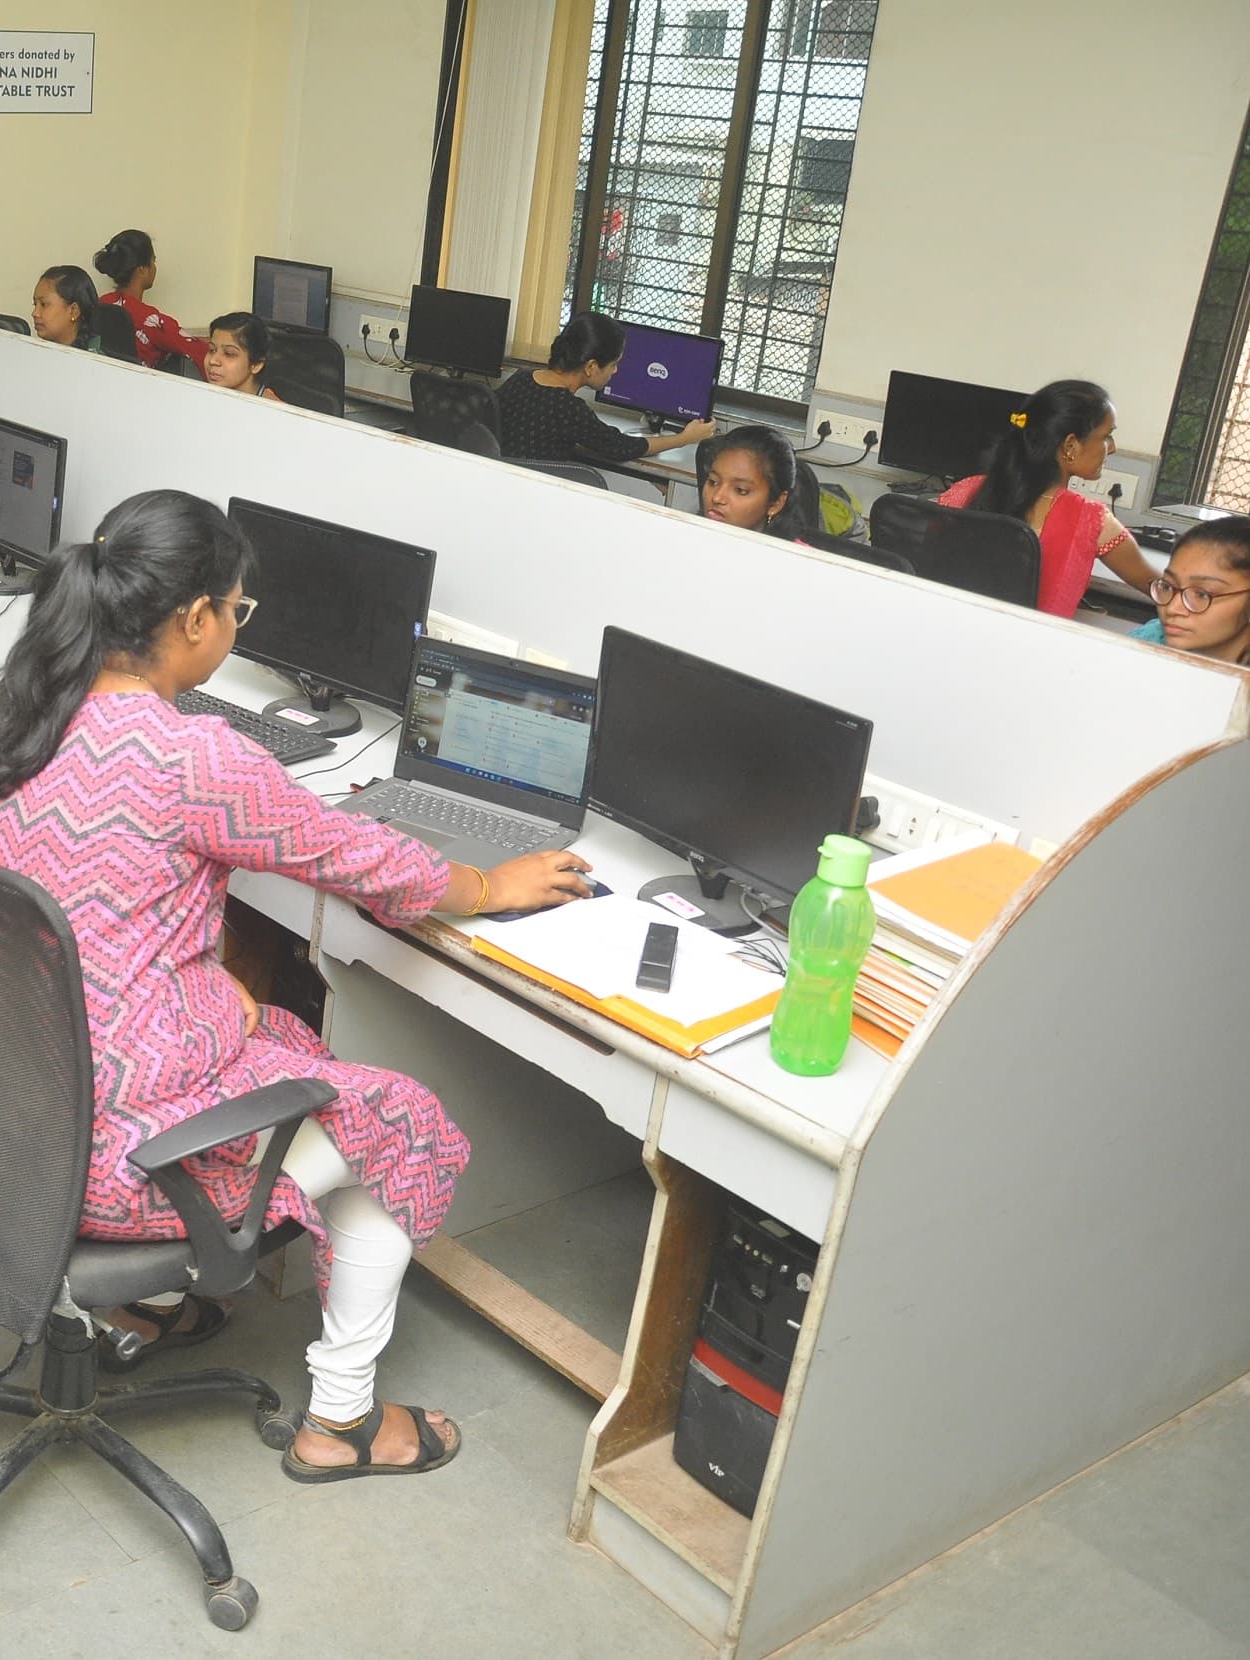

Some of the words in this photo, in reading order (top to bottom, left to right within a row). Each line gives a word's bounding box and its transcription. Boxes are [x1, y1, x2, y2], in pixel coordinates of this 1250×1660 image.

[18, 48, 60, 60] donated
[63, 49, 75, 62] by
[21, 67, 57, 79] NIDHI
[36, 85, 75, 97] TRUST
